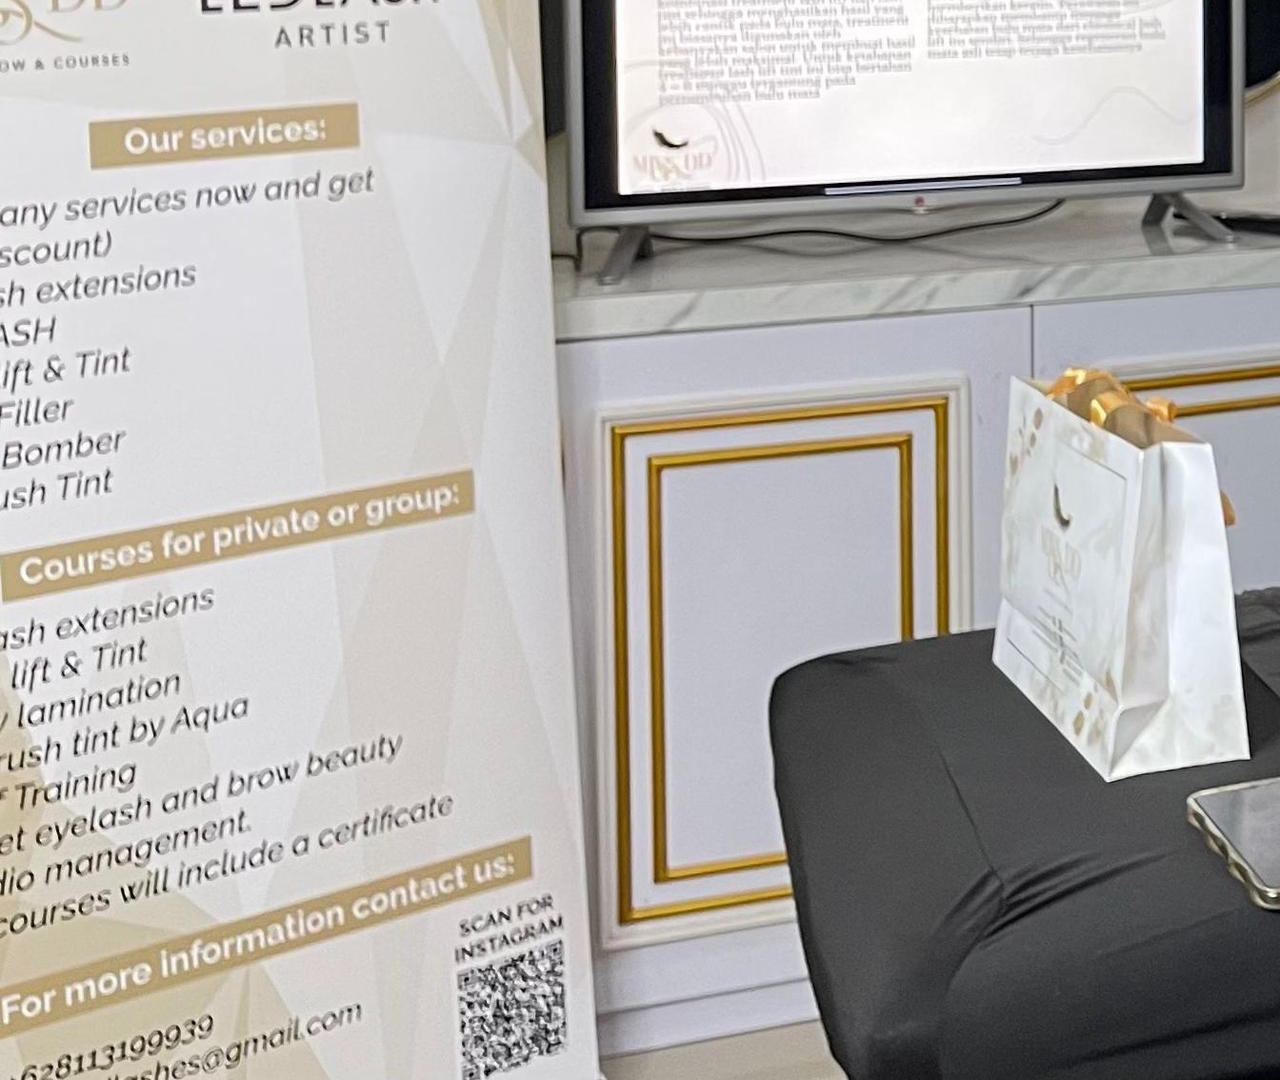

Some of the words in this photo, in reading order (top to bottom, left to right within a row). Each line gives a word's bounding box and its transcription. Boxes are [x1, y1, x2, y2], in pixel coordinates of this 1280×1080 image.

[274, 21, 391, 49] ARTIST
[54, 54, 130, 70] COURSES
[124, 126, 183, 155] Our
[191, 118, 326, 151] services:
[0, 202, 57, 231] any
[65, 184, 187, 222] services
[195, 182, 257, 208] now
[264, 170, 321, 201] and
[328, 166, 375, 201] get
[36, 262, 197, 304] extensions
[44, 353, 66, 383] &
[76, 346, 131, 378] Tint
[2, 427, 127, 470] Bomber
[57, 467, 114, 501] Tint
[19, 537, 154, 586] Courses
[162, 530, 206, 559] for
[213, 510, 320, 556] private
[328, 501, 360, 527] or
[366, 483, 460, 526] group:
[56, 587, 214, 640] extensions
[11, 655, 51, 693] lift
[61, 650, 83, 680] &
[93, 637, 148, 672] Tint
[18, 673, 180, 729] lamination
[73, 720, 120, 758] tint
[130, 714, 166, 748] by
[170, 695, 249, 735] Aqua
[16, 762, 136, 810] Training
[35, 793, 152, 851] eyelash
[160, 781, 220, 815] and
[226, 761, 300, 799] brow
[305, 732, 404, 776] beauty
[45, 809, 253, 885] management.
[120, 863, 169, 905] will
[177, 840, 285, 889] include
[291, 834, 311, 858] a
[317, 790, 455, 851] certificate
[1, 987, 56, 1021] For
[64, 961, 153, 1009] more
[161, 901, 347, 975] information
[351, 866, 468, 921] contact
[473, 851, 517, 886] us:
[454, 913, 564, 963] INSTAGRAM
[458, 905, 512, 937] SCAN
[516, 892, 553, 919] FOR
[11, 1014, 214, 1080] 628113199939
